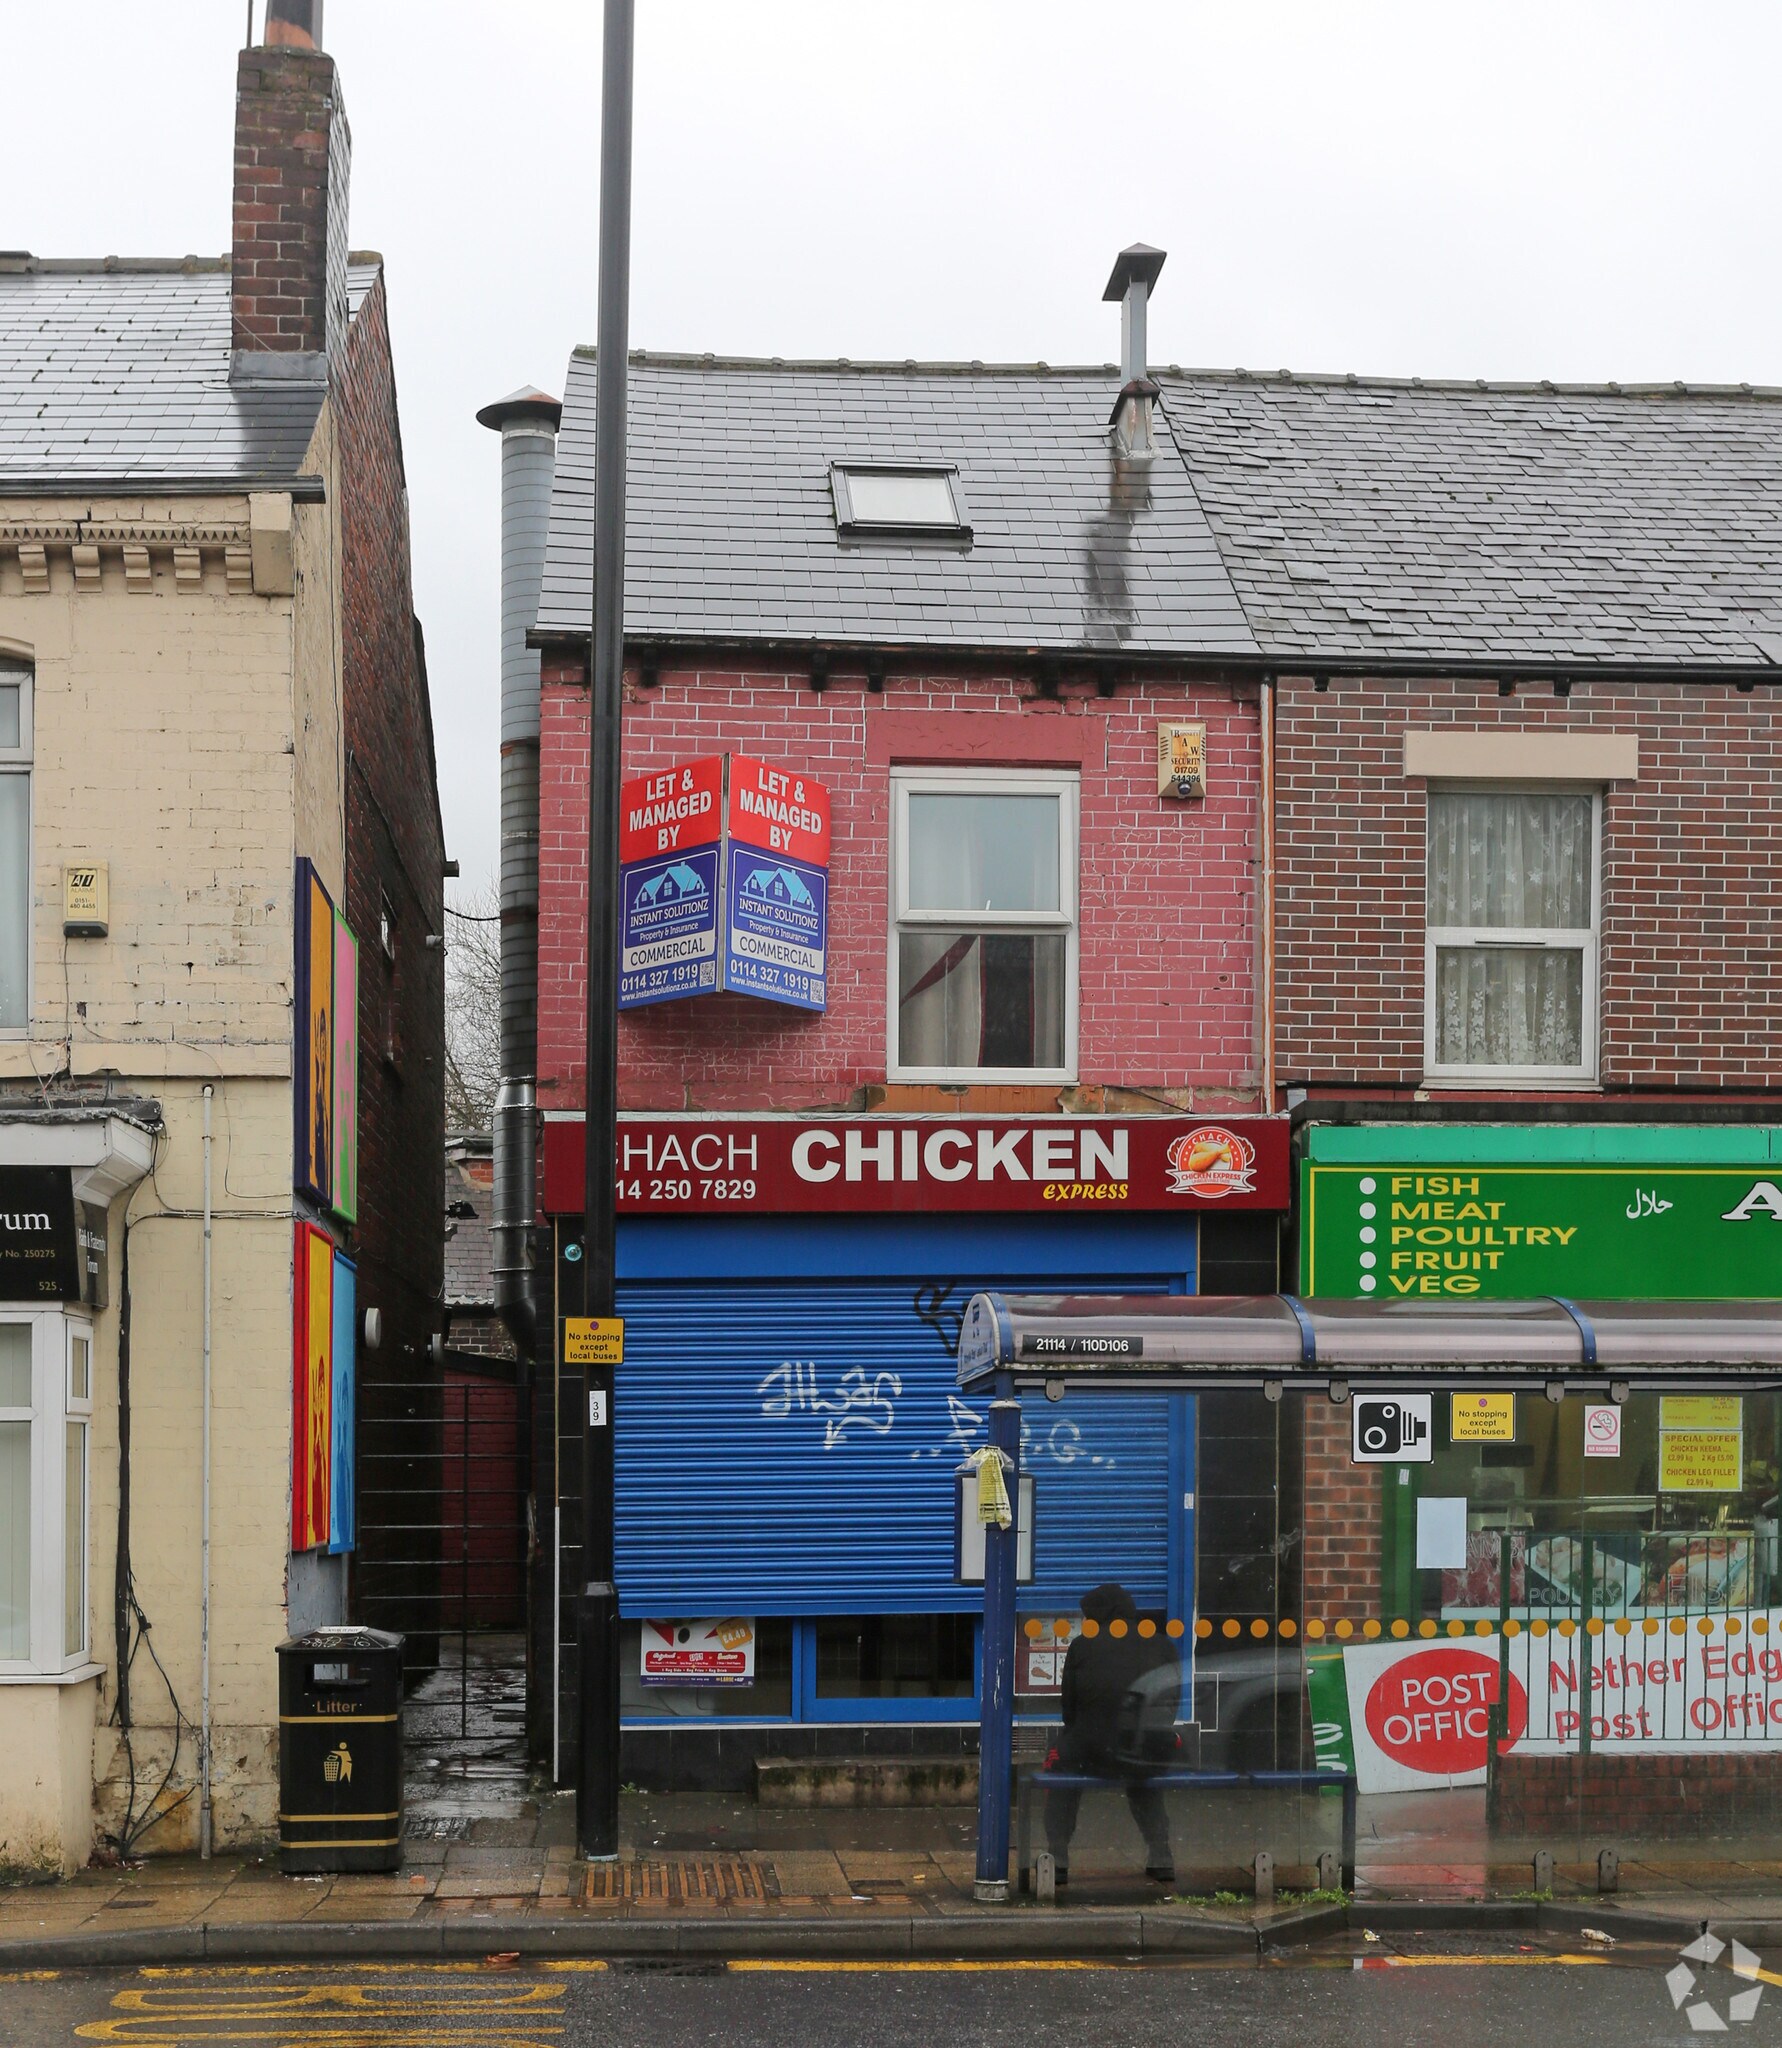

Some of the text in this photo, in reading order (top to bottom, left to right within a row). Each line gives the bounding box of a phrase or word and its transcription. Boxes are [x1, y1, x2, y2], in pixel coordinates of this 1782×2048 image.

[646, 768, 695, 801] LET &
[758, 768, 806, 803] LET &
[629, 791, 712, 832] MANAGED
[740, 788, 822, 835] MANAGED
[657, 825, 681, 851] BY
[769, 825, 793, 851] BY
[630, 899, 709, 928] INSTANT SOLUTIONZ
[739, 897, 819, 929] INSTANT SOLUTIONZ
[639, 922, 699, 942] Property & Insurance
[749, 920, 809, 944] Property & Insurance
[630, 937, 706, 967] COMMERCIAL
[739, 936, 816, 969] COMMERCIAL
[621, 964, 698, 992] 0114 327 1919
[730, 958, 809, 991] 0114 327 1919
[621, 980, 698, 1001] www.instantsolutionz.co.uk
[730, 975, 809, 1001] www.instantsolutionz.co.uk
[1192, 1132, 1231, 1145] CHACH
[615, 1129, 1129, 1183] HACH CHICKEN
[1181, 1172, 1241, 1181] CHICKEN EXPRESS
[1391, 1177, 1480, 1196] FISH
[615, 1179, 756, 1199] 14 250 7829
[1043, 1183, 1129, 1201] EXPRESS
[1391, 1202, 1506, 1221] MEAT
[1626, 1188, 1674, 1220] حلال
[1391, 1226, 1578, 1245] POULTRY
[24, 1250, 56, 1258] 250275
[1391, 1251, 1504, 1270] FRUIT
[39, 1282, 57, 1290] 525
[1388, 1275, 1481, 1294] VEG
[583, 1333, 620, 1343] stopping
[1036, 1338, 1066, 1350] 21114
[1081, 1339, 1129, 1352] 110D106
[580, 1344, 608, 1353] except
[593, 1352, 618, 1360] buses
[1458, 1410, 1508, 1419] No stopping
[1469, 1420, 1497, 1428] except
[1686, 1454, 1693, 1462] kg
[1706, 1479, 1713, 1487] kg
[1550, 1654, 1687, 1694] Nether
[1402, 1672, 1491, 1708] POST
[316, 1701, 357, 1713] Litter
[1383, 1708, 1510, 1744] OFFIC
[1555, 1704, 1653, 1744] Post
